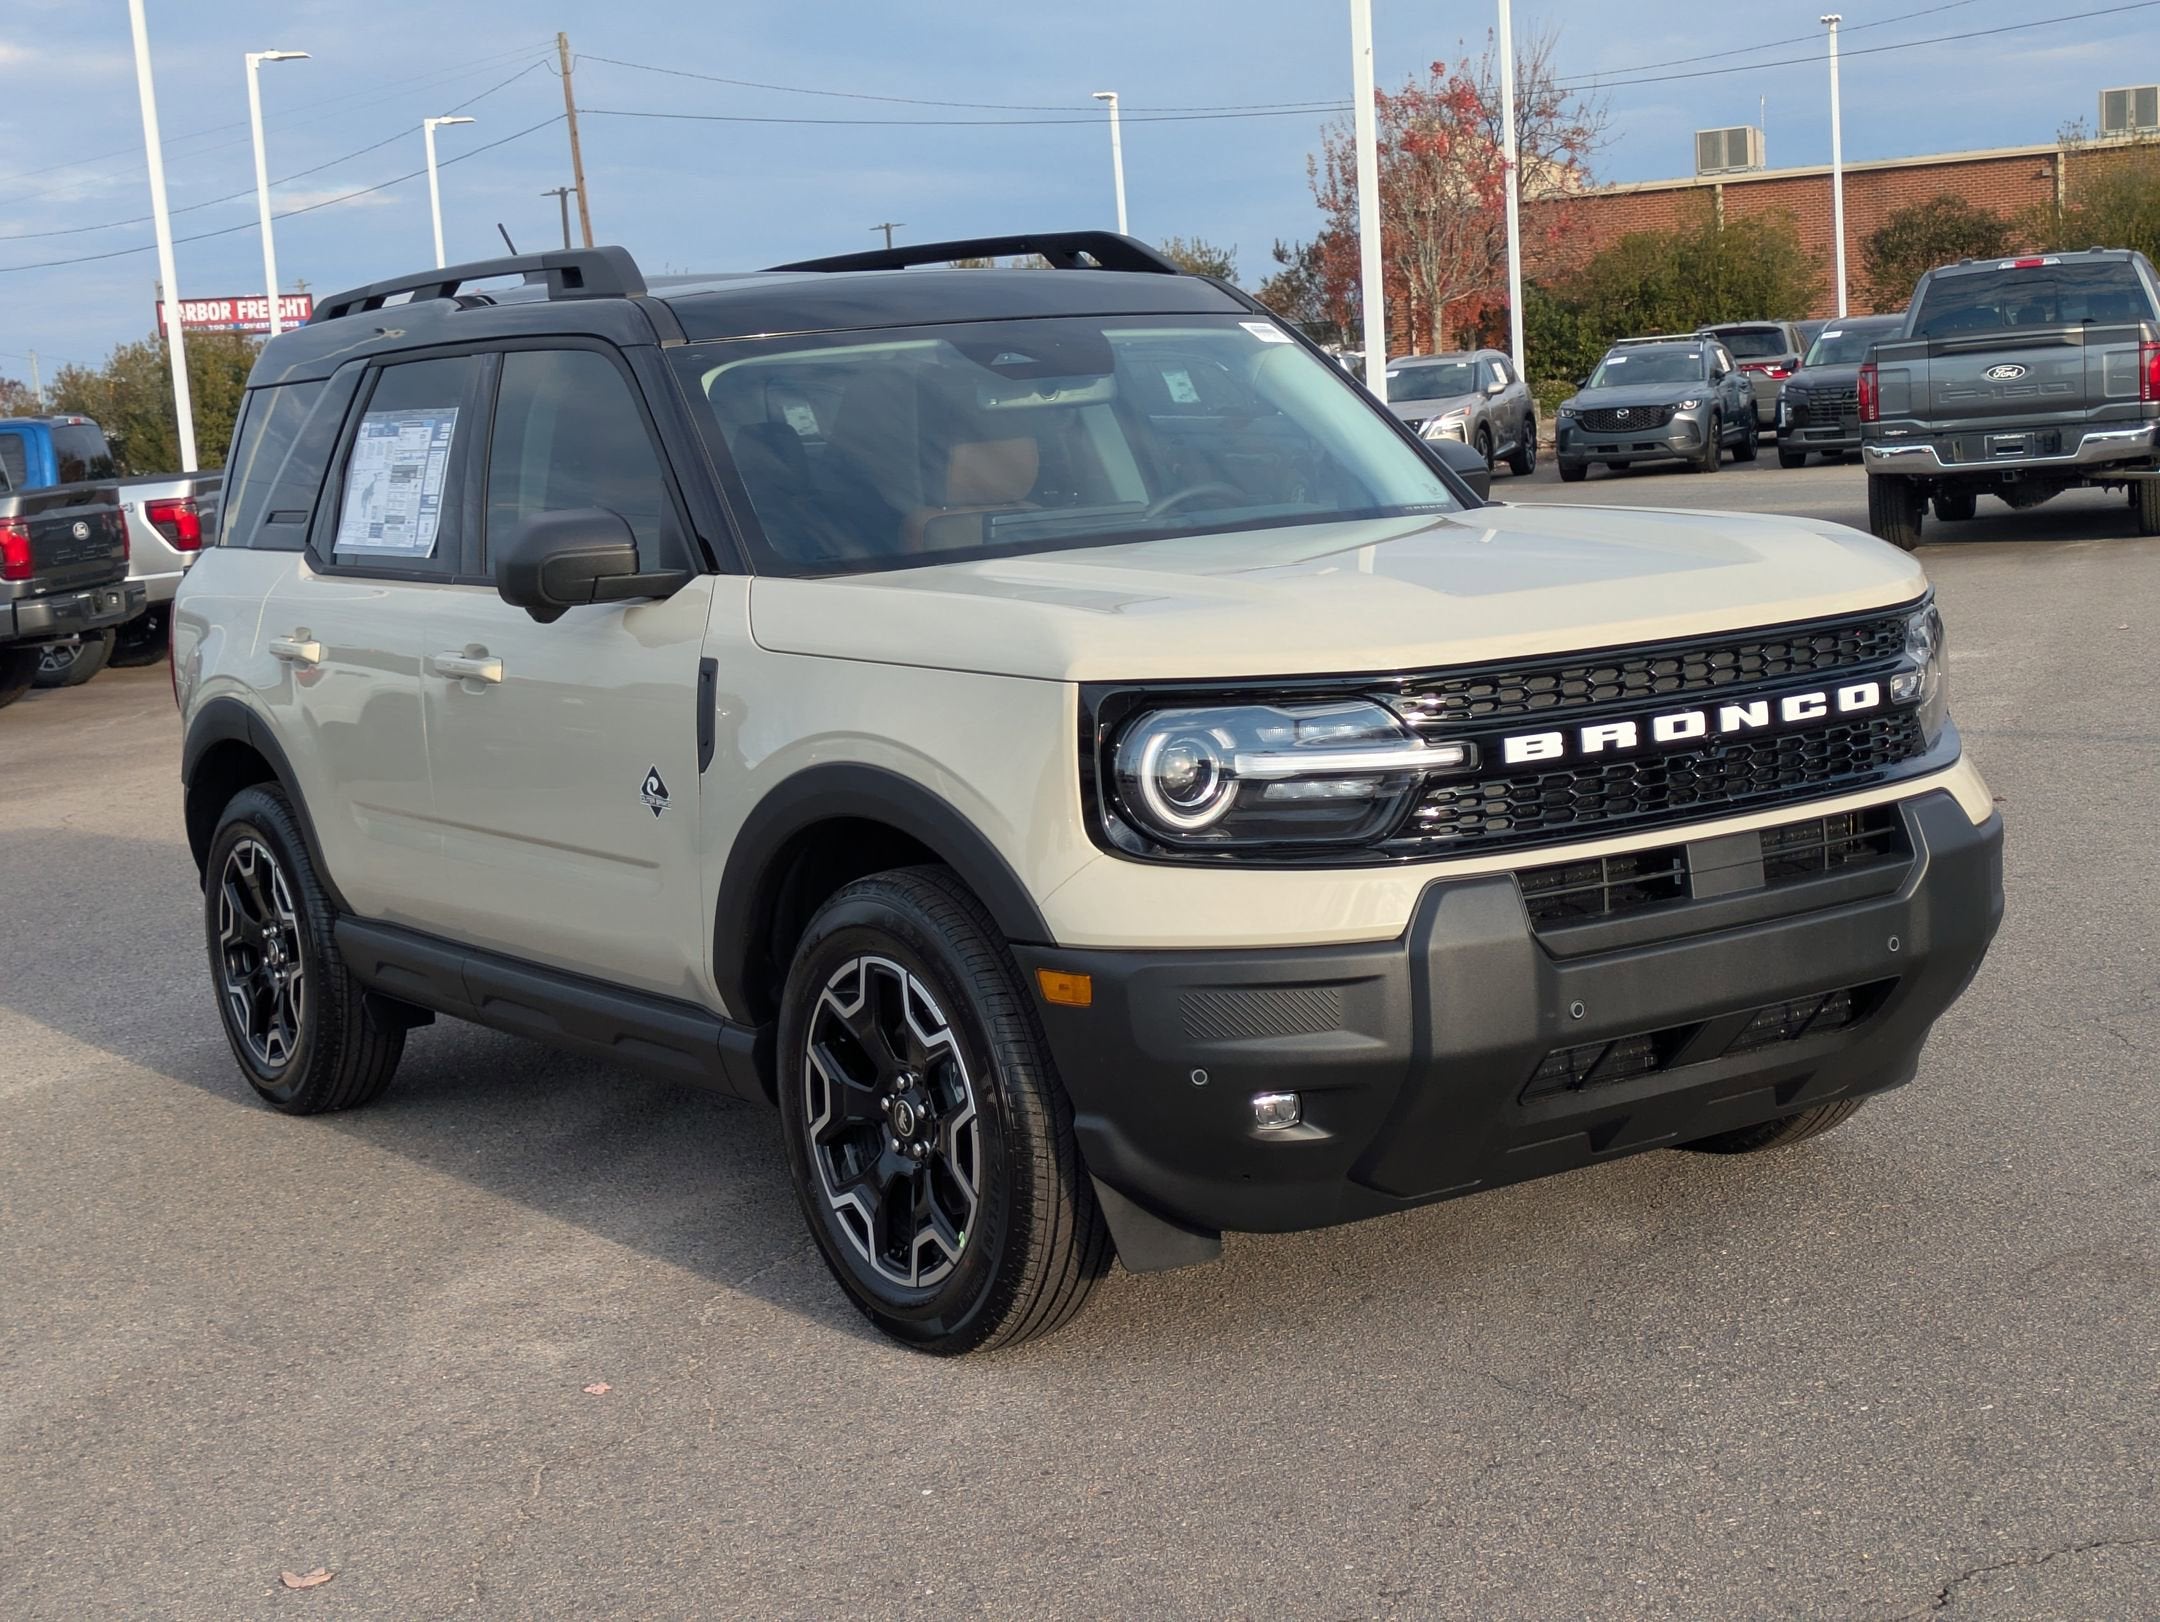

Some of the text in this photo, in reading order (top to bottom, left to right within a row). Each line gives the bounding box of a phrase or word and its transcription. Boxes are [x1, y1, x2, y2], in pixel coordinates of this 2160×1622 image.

[237, 297, 308, 320] FREGHT
[1939, 381, 2075, 403] F-150
[1504, 682, 1880, 764] BRONCO
